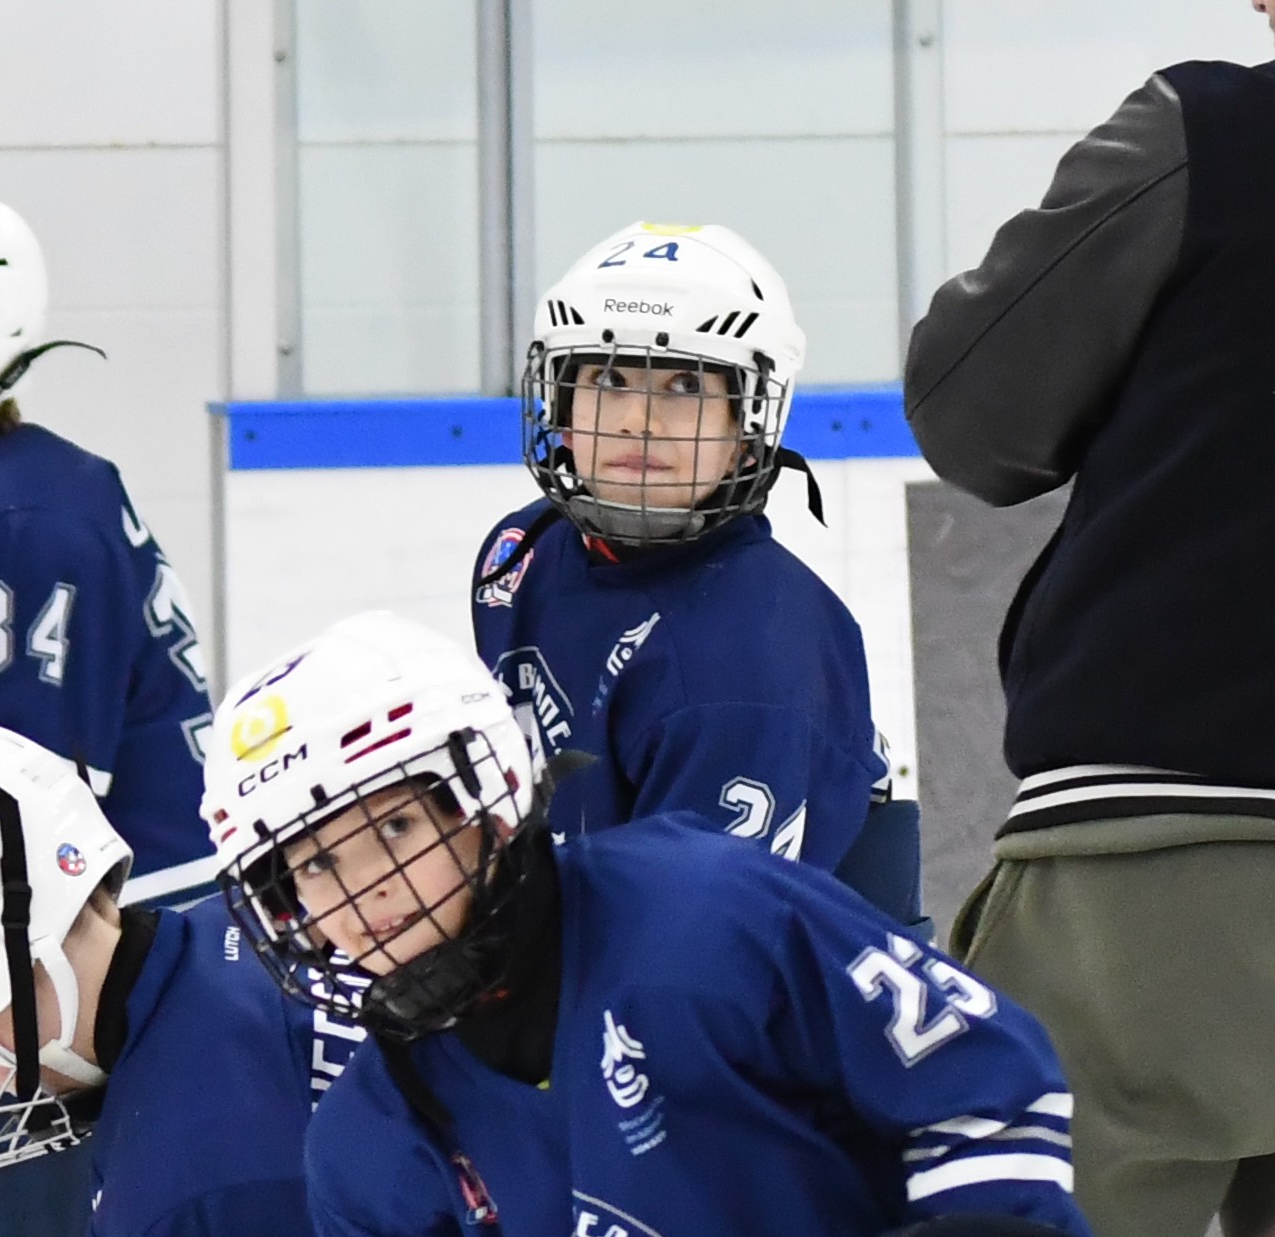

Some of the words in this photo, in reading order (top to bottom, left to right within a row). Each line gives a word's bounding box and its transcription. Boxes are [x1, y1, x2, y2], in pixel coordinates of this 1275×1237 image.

[597, 241, 678, 268] 24
[603, 298, 674, 316] Reebok
[238, 743, 308, 797] CCM
